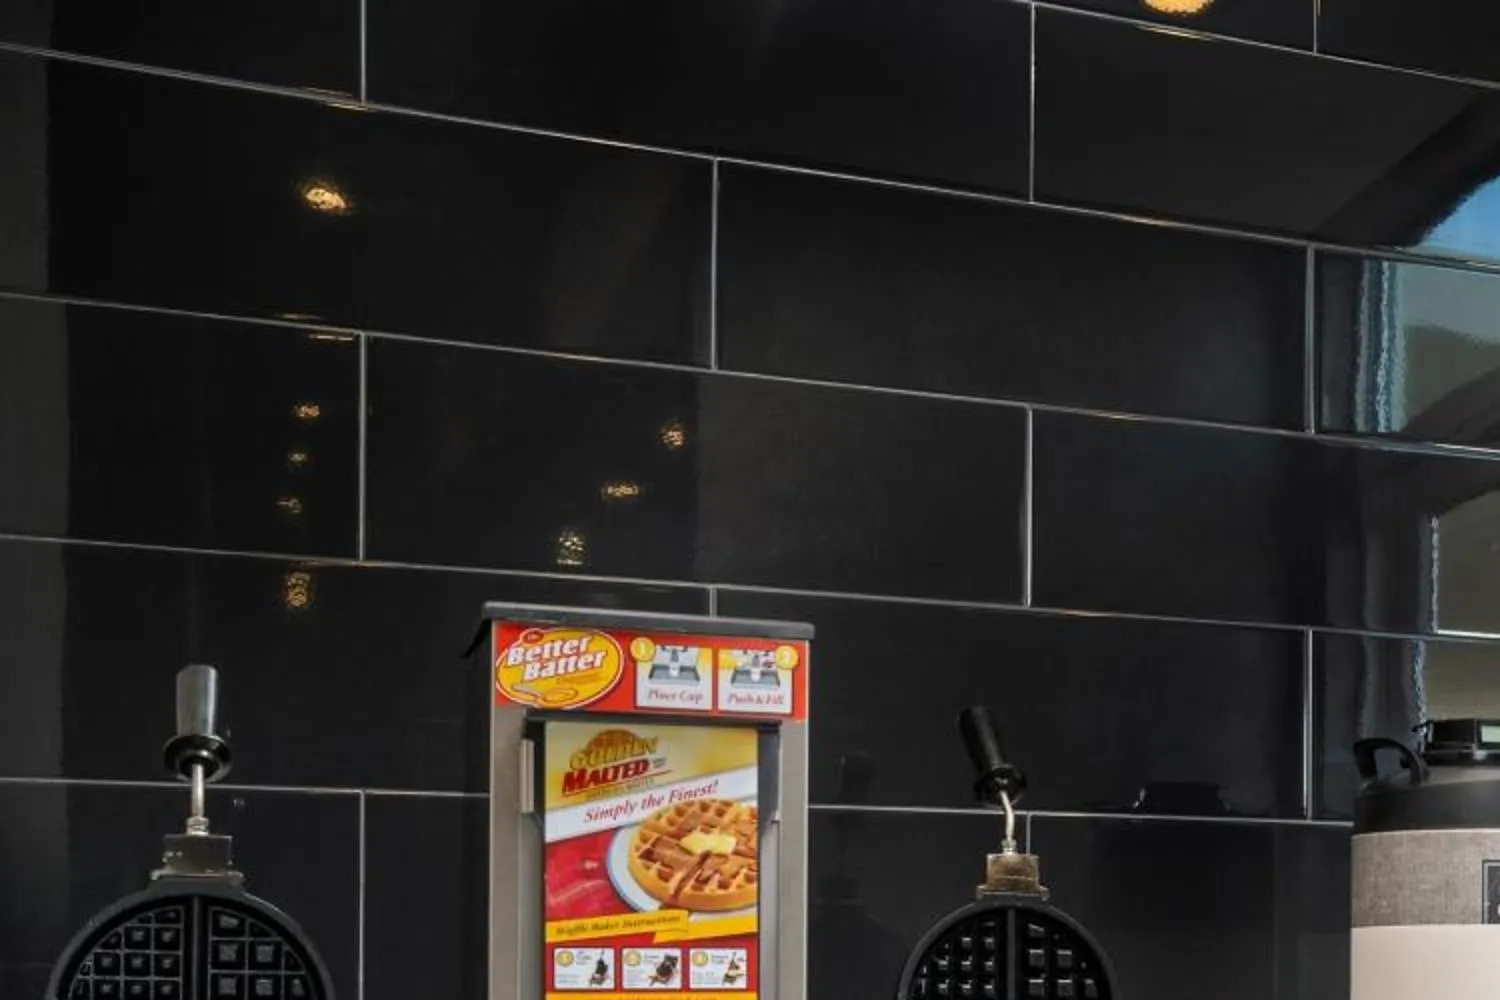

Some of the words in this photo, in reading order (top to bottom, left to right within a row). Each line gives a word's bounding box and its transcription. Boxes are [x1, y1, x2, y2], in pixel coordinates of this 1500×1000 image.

[506, 636, 593, 667] Better
[523, 651, 606, 682] Batter
[562, 758, 650, 795] MALTED
[583, 799, 637, 824] Simply
[640, 791, 665, 808] the
[668, 777, 720, 803] Finest!
